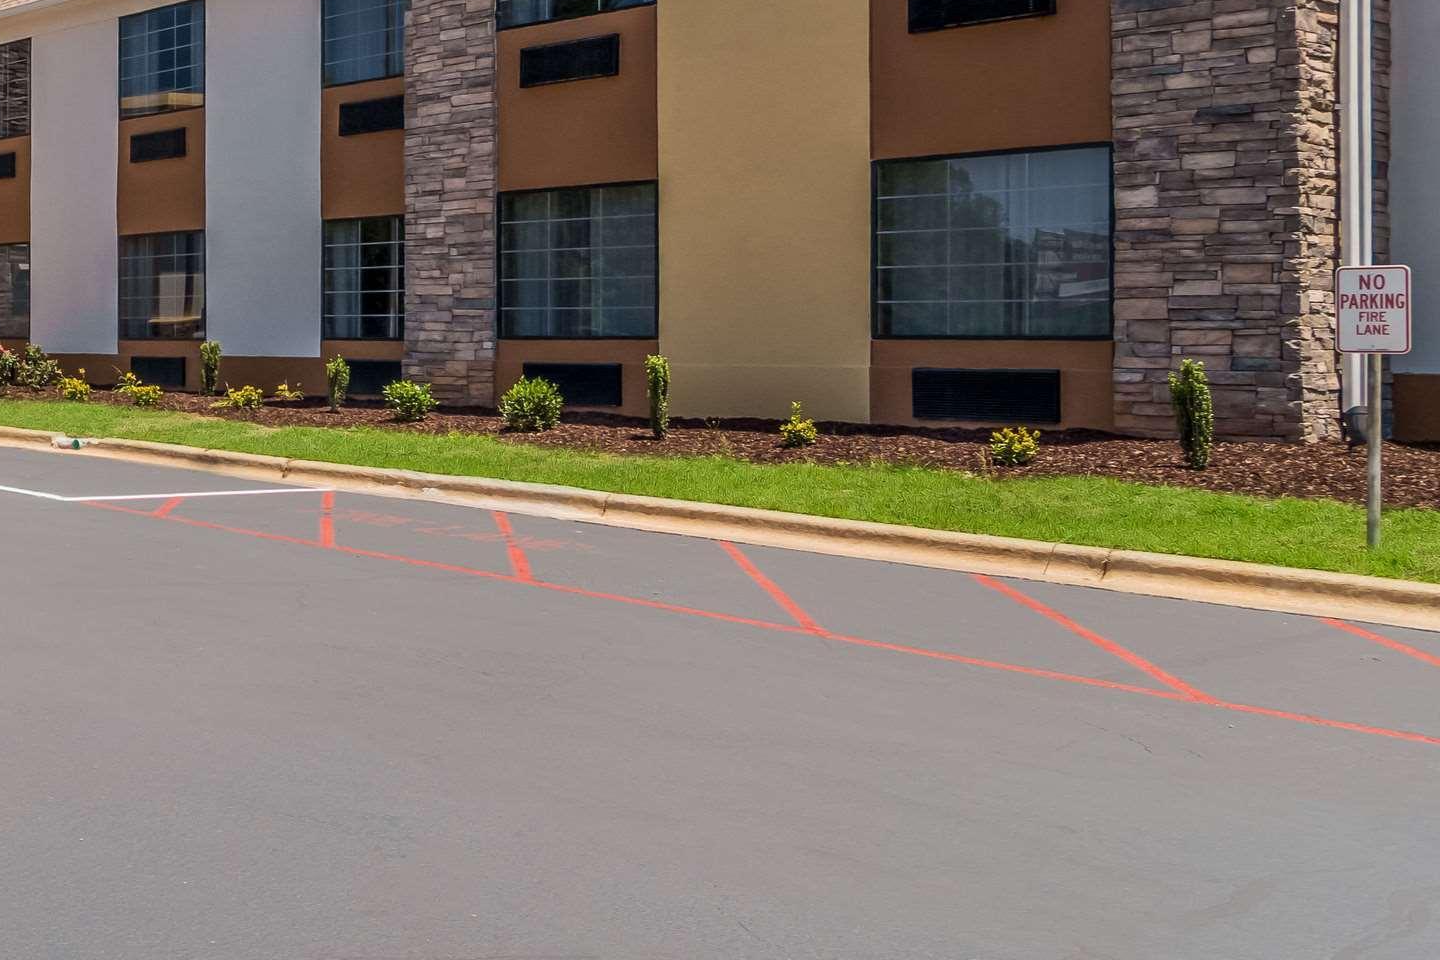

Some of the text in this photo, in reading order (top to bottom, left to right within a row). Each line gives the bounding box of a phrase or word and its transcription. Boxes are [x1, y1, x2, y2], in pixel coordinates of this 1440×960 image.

[1358, 274, 1386, 290] NO
[1340, 293, 1406, 310] PARKING
[1358, 311, 1388, 323] FIRE
[1356, 324, 1391, 336] LANE
